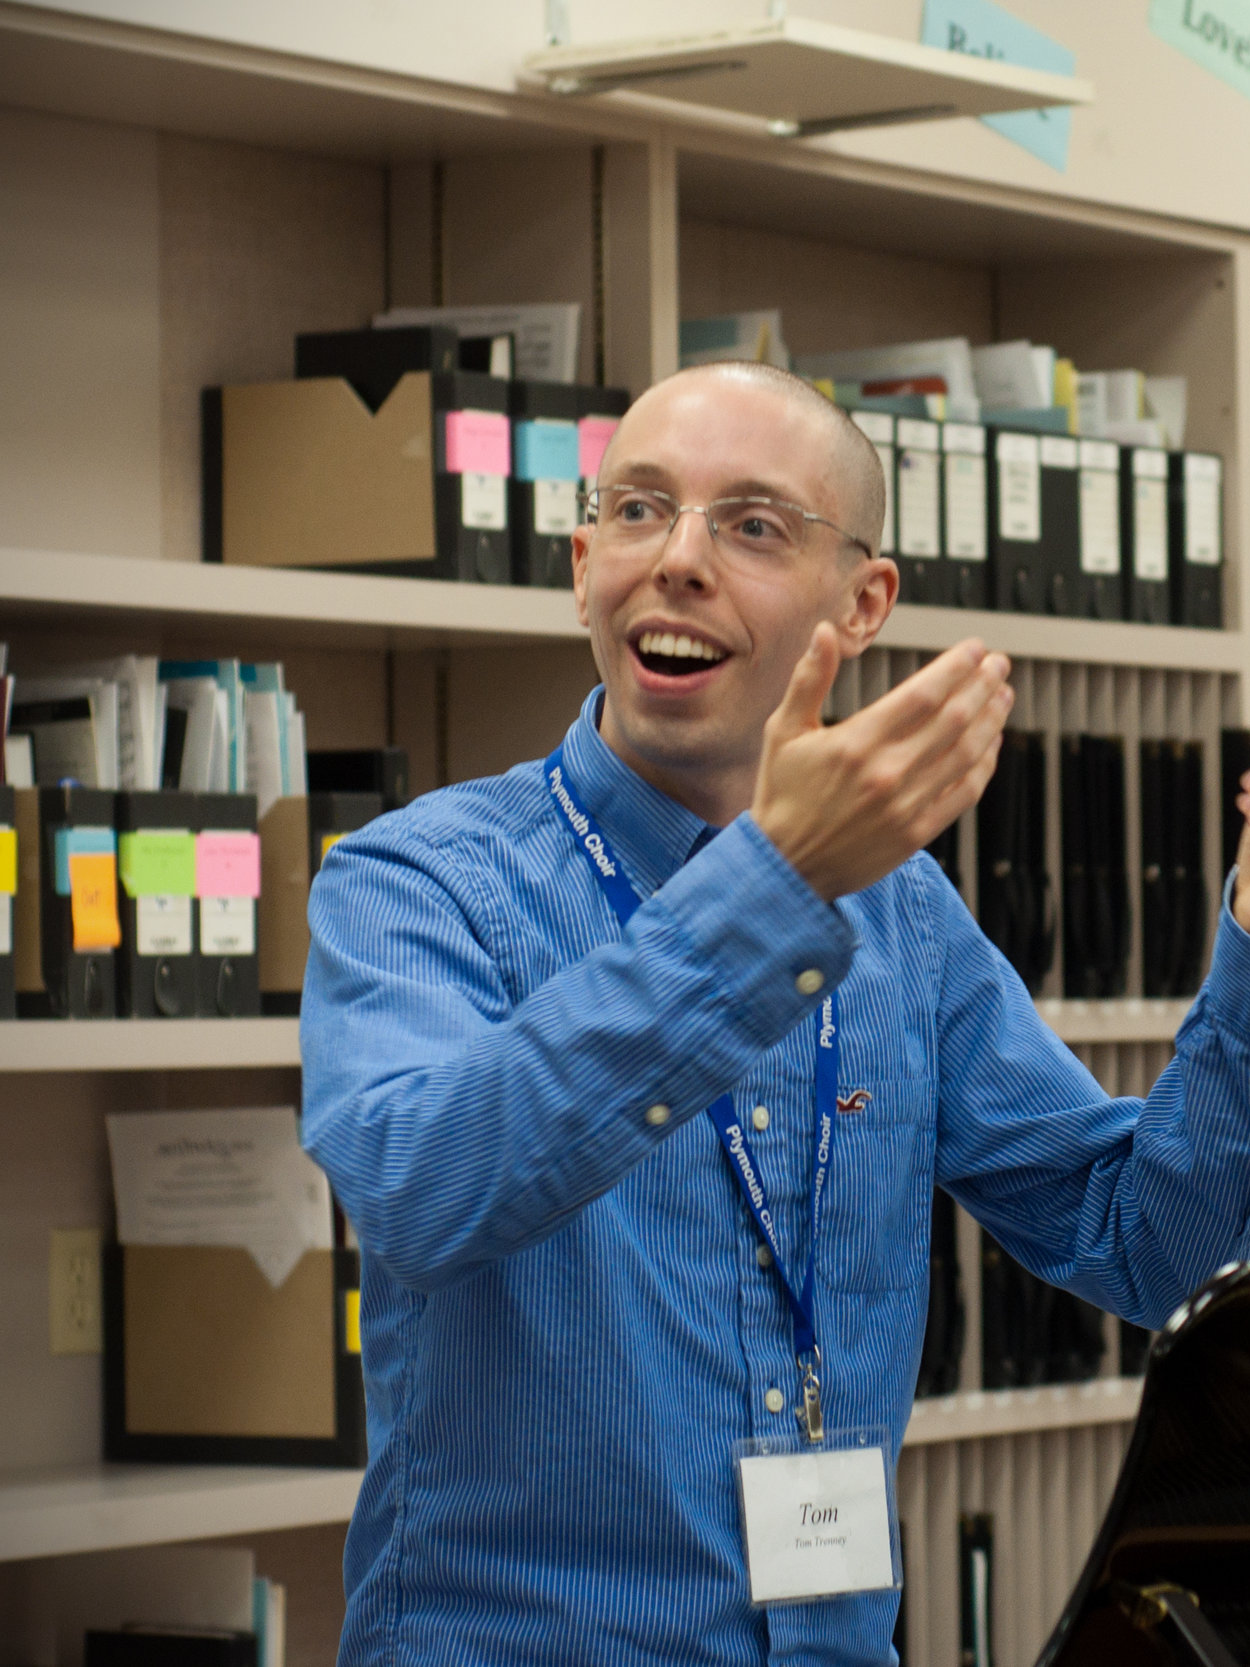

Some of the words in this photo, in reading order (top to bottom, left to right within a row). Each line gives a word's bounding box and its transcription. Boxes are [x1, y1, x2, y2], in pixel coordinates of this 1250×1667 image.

[549, 766, 589, 836] Plymouth
[584, 833, 616, 877] Choir
[818, 1112, 831, 1164] Choir
[726, 1123, 764, 1210] Plymouth
[799, 1502, 838, 1526] Tom
[795, 1537, 812, 1549] Tom
